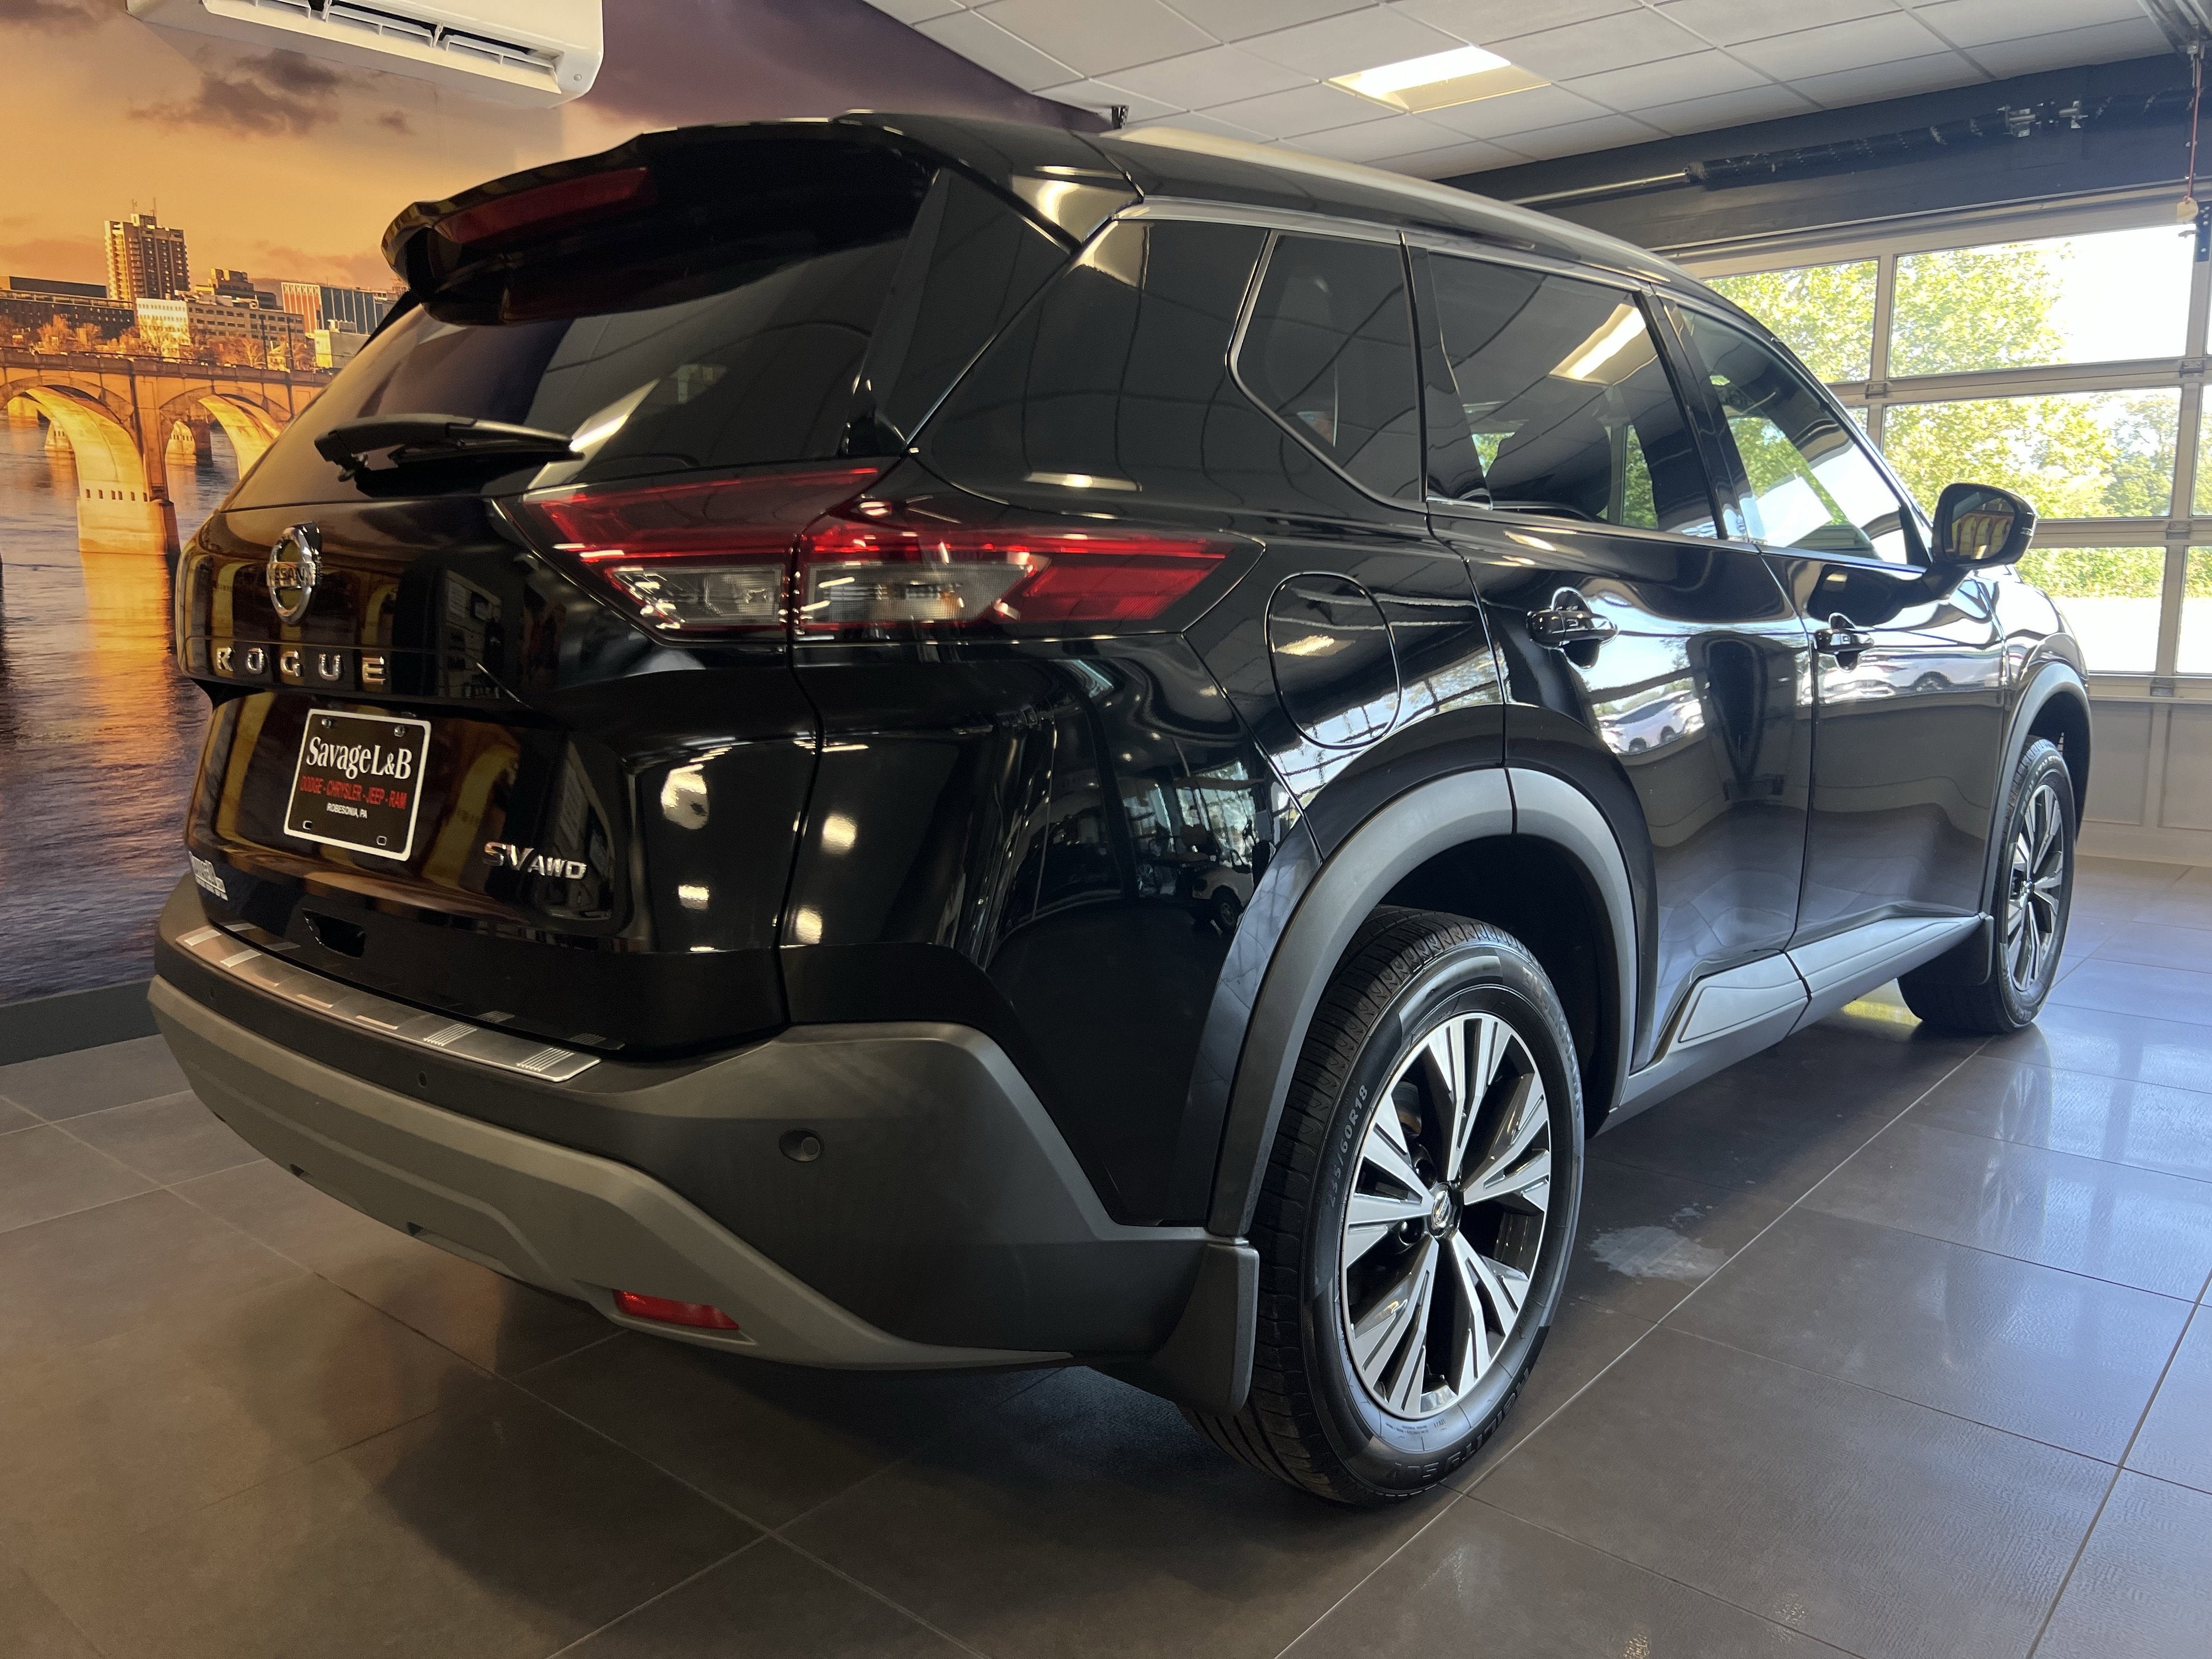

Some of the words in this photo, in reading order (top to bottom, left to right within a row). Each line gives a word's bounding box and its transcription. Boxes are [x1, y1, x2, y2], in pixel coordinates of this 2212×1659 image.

[216, 647, 386, 685] ROGUE
[300, 776, 324, 794] DODGE
[326, 780, 362, 802] CHRYSLER
[365, 787, 385, 805] JEEP
[388, 791, 408, 810] RAM
[360, 809, 368, 819] PA
[483, 842, 535, 871] SV
[527, 854, 587, 879] AWD
[1327, 1085, 1368, 1207] 235/60R18
